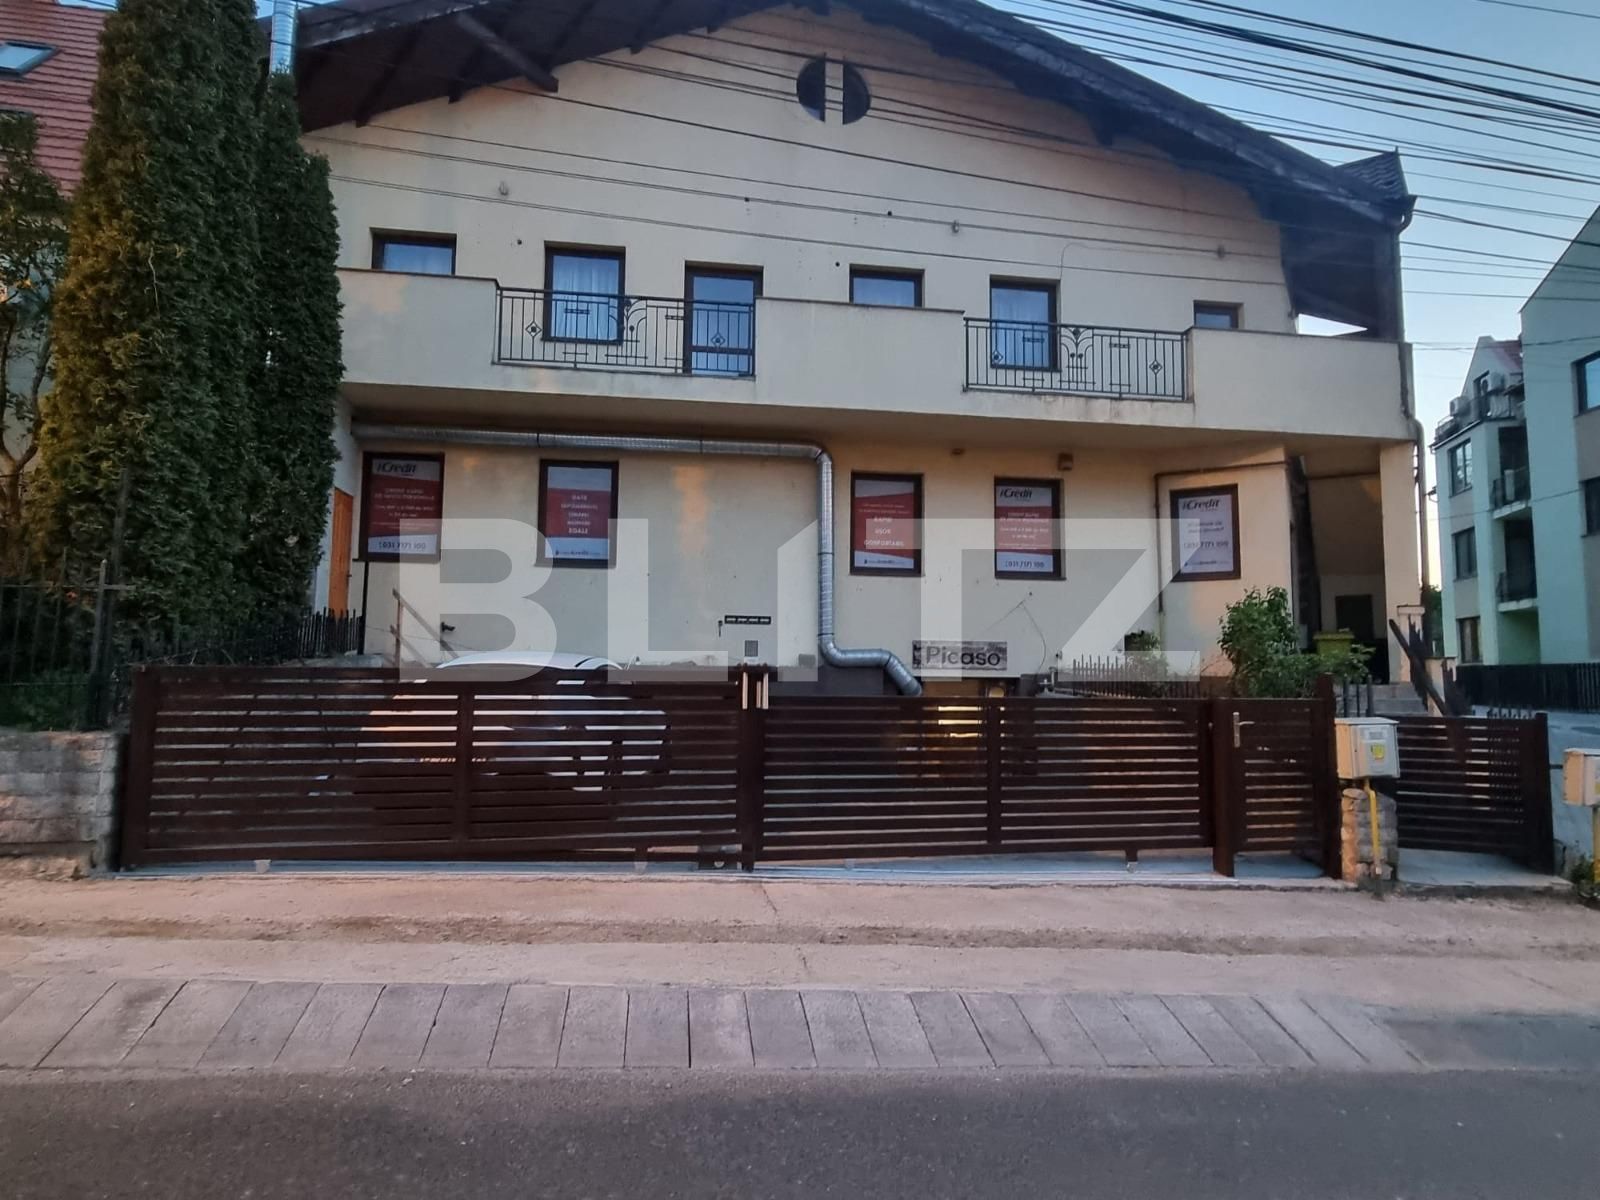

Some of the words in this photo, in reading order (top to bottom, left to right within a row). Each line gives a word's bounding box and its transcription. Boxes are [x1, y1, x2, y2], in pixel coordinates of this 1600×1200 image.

[1000, 487, 1032, 498] iCredit
[1182, 499, 1220, 510] iCredit
[926, 645, 1001, 667] Picaso
